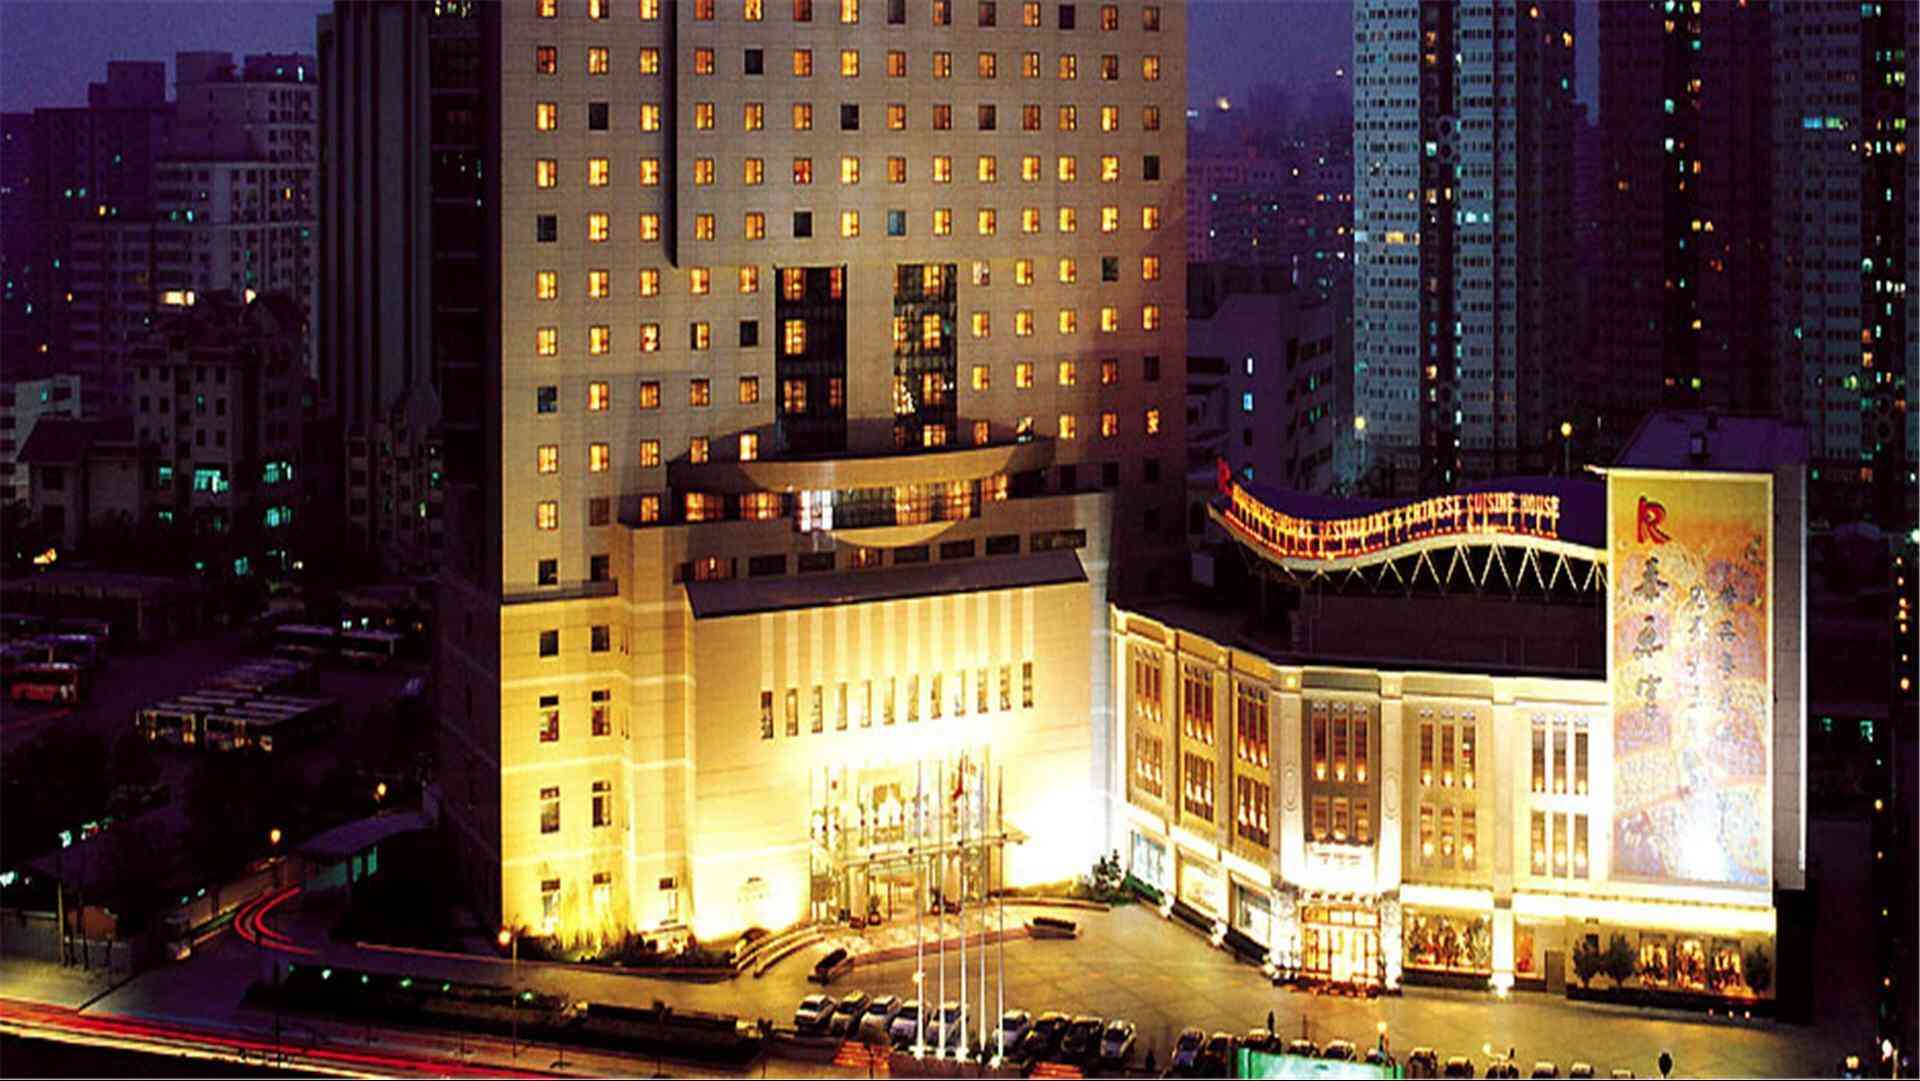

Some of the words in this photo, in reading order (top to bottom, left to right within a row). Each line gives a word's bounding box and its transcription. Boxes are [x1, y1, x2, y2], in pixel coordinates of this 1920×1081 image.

[1406, 494, 1463, 524] CHINESE
[1467, 492, 1518, 514] CUISINE
[1520, 494, 1559, 518] HOUSE
